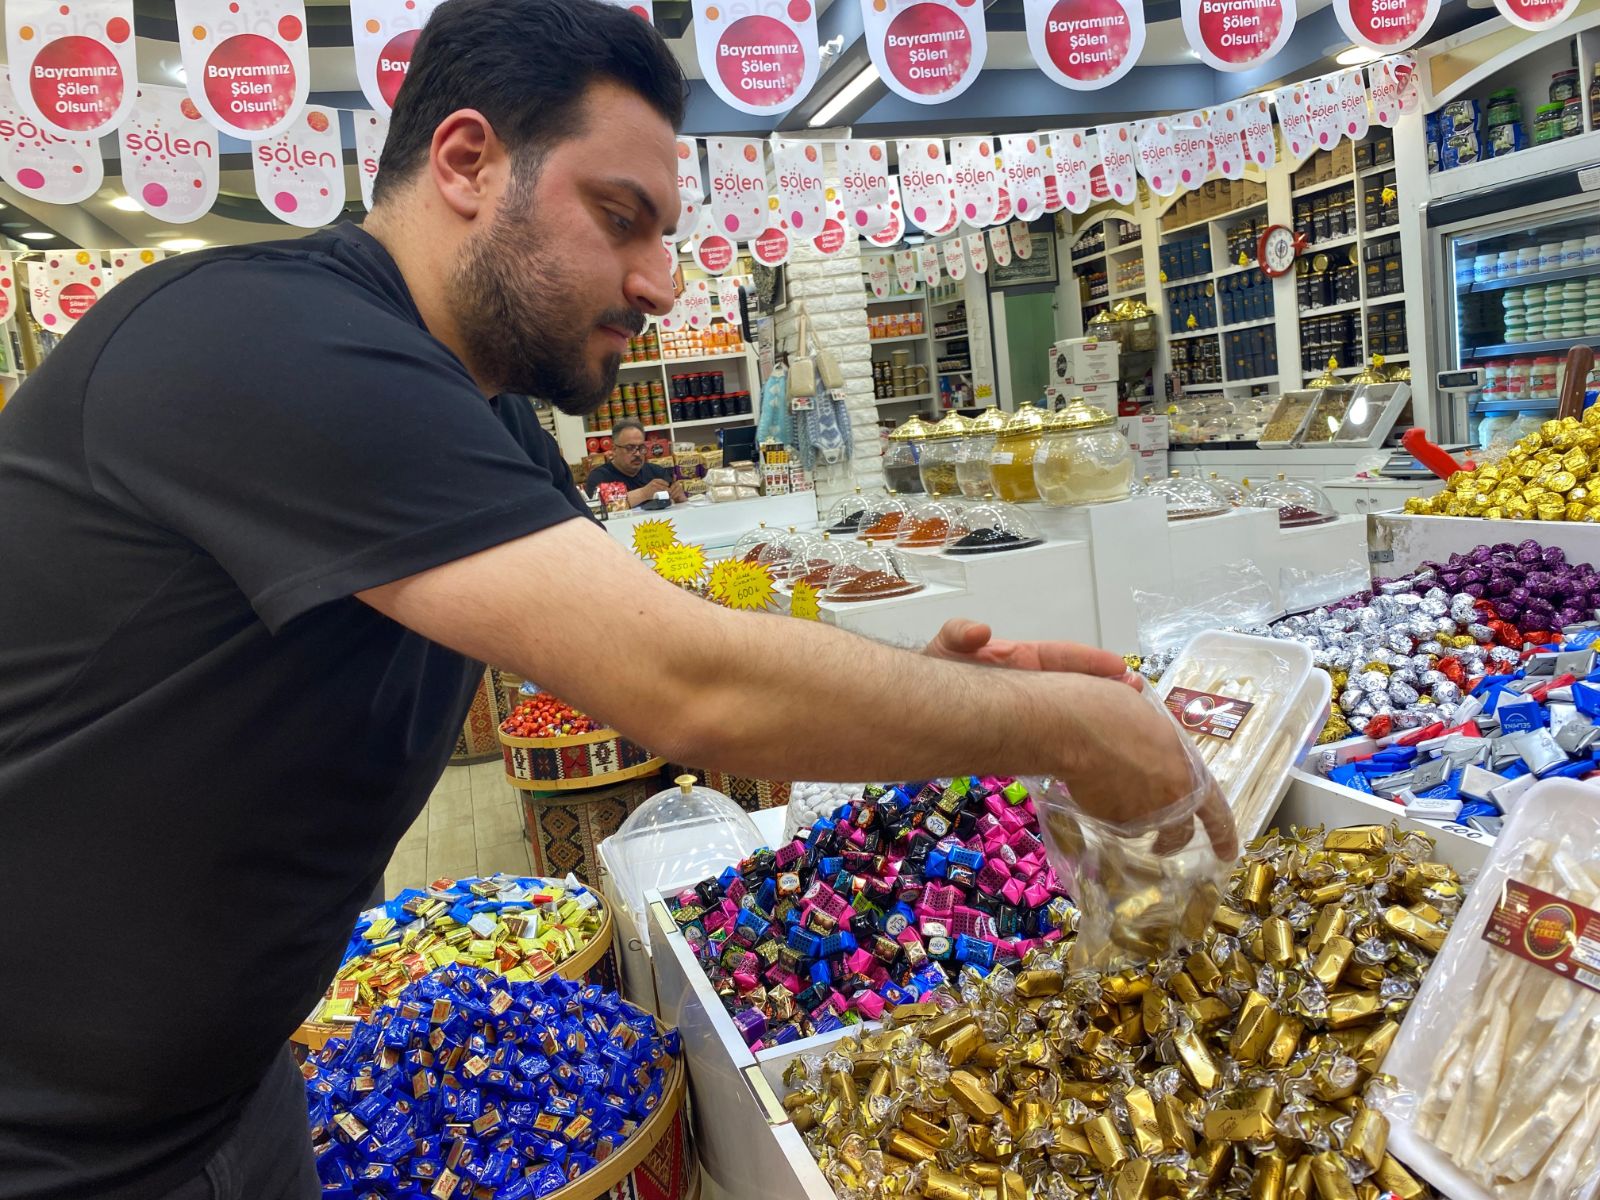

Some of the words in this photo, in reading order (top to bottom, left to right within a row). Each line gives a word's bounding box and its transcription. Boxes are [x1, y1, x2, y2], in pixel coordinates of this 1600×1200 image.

[1048, 15, 1125, 33] Bayramınız
[1222, 14, 1260, 31] Şölen
[1370, 13, 1411, 29] Olsun!
[888, 28, 966, 47] Bayramınız
[1069, 34, 1109, 50] Şölen
[1220, 31, 1264, 47] Olsun!
[720, 43, 799, 57] Bayramınız
[908, 47, 949, 64] Şölen
[1068, 50, 1113, 65] Olsun!
[34, 64, 118, 79] Bayramınız
[207, 63, 291, 79] Bayramınız
[741, 59, 781, 75] Şölen
[908, 64, 953, 79] Olsun!
[56, 82, 99, 97] Şölen
[231, 81, 273, 96] Şölen
[740, 76, 786, 90] Olsun!
[55, 99, 104, 114] Olsun!
[230, 98, 278, 113] Olsun!
